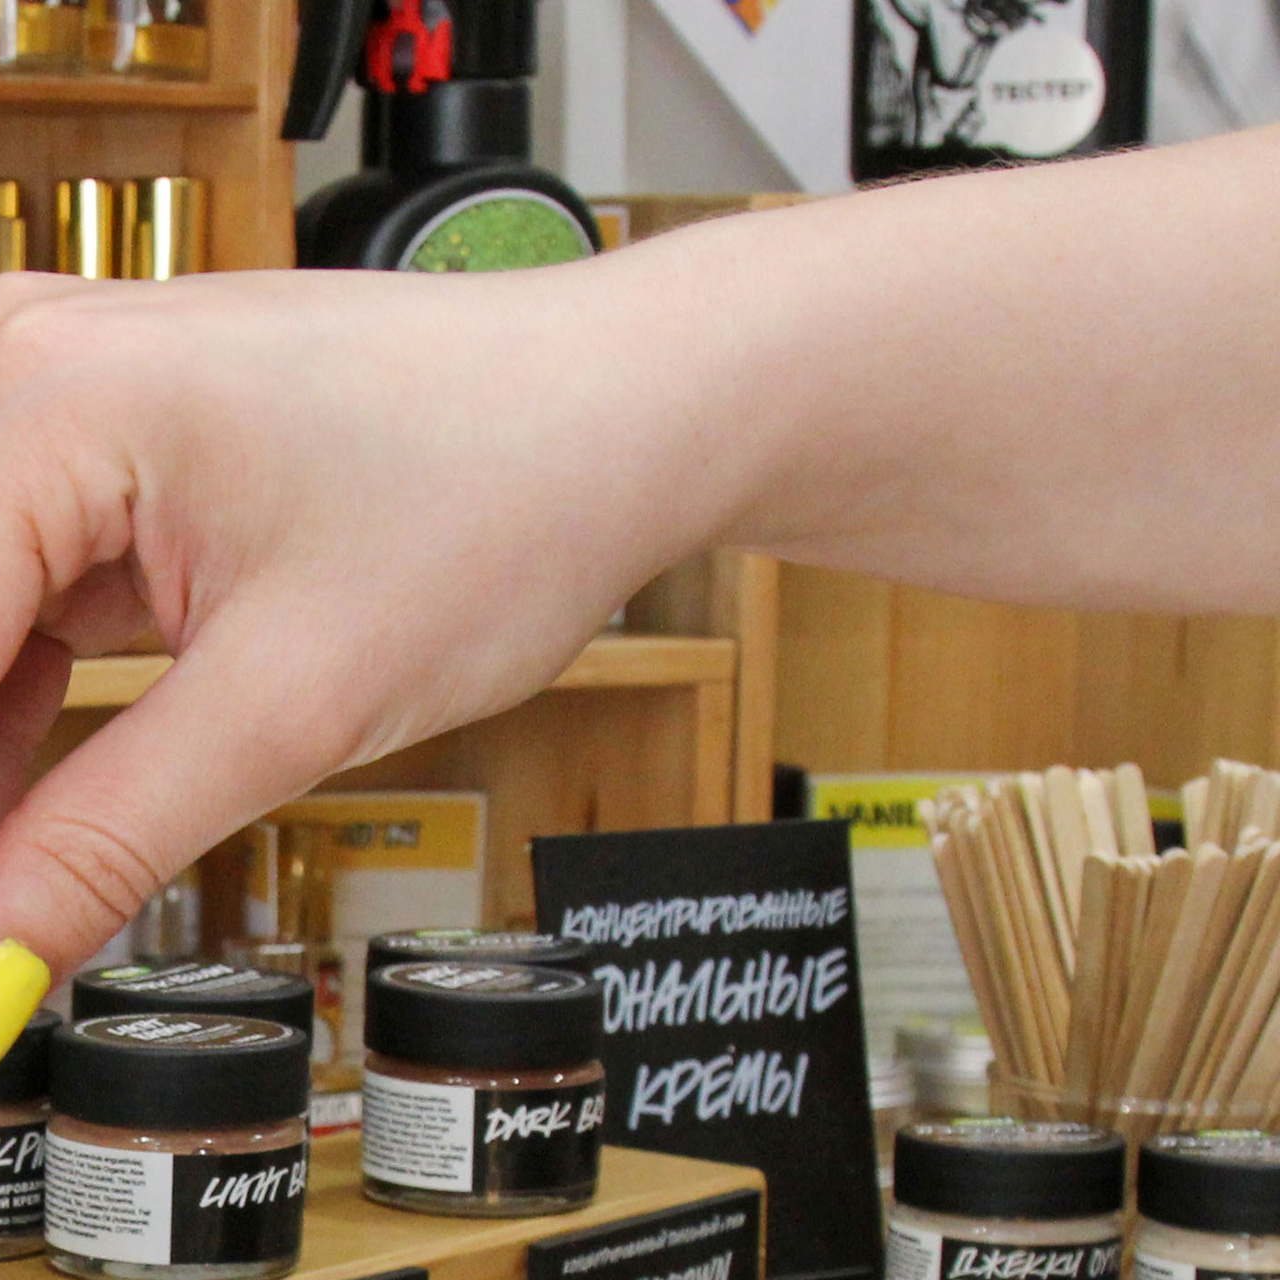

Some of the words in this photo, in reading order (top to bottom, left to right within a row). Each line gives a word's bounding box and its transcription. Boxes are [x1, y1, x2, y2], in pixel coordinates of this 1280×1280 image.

[990, 80, 1091, 102] ТЕСТЕР
[627, 1050, 809, 1130] КРЕМЫ
[484, 1102, 571, 1144] DARK
[200, 1166, 289, 1208] LIGHT
[947, 1246, 1084, 1280] ДЖЕККИ
